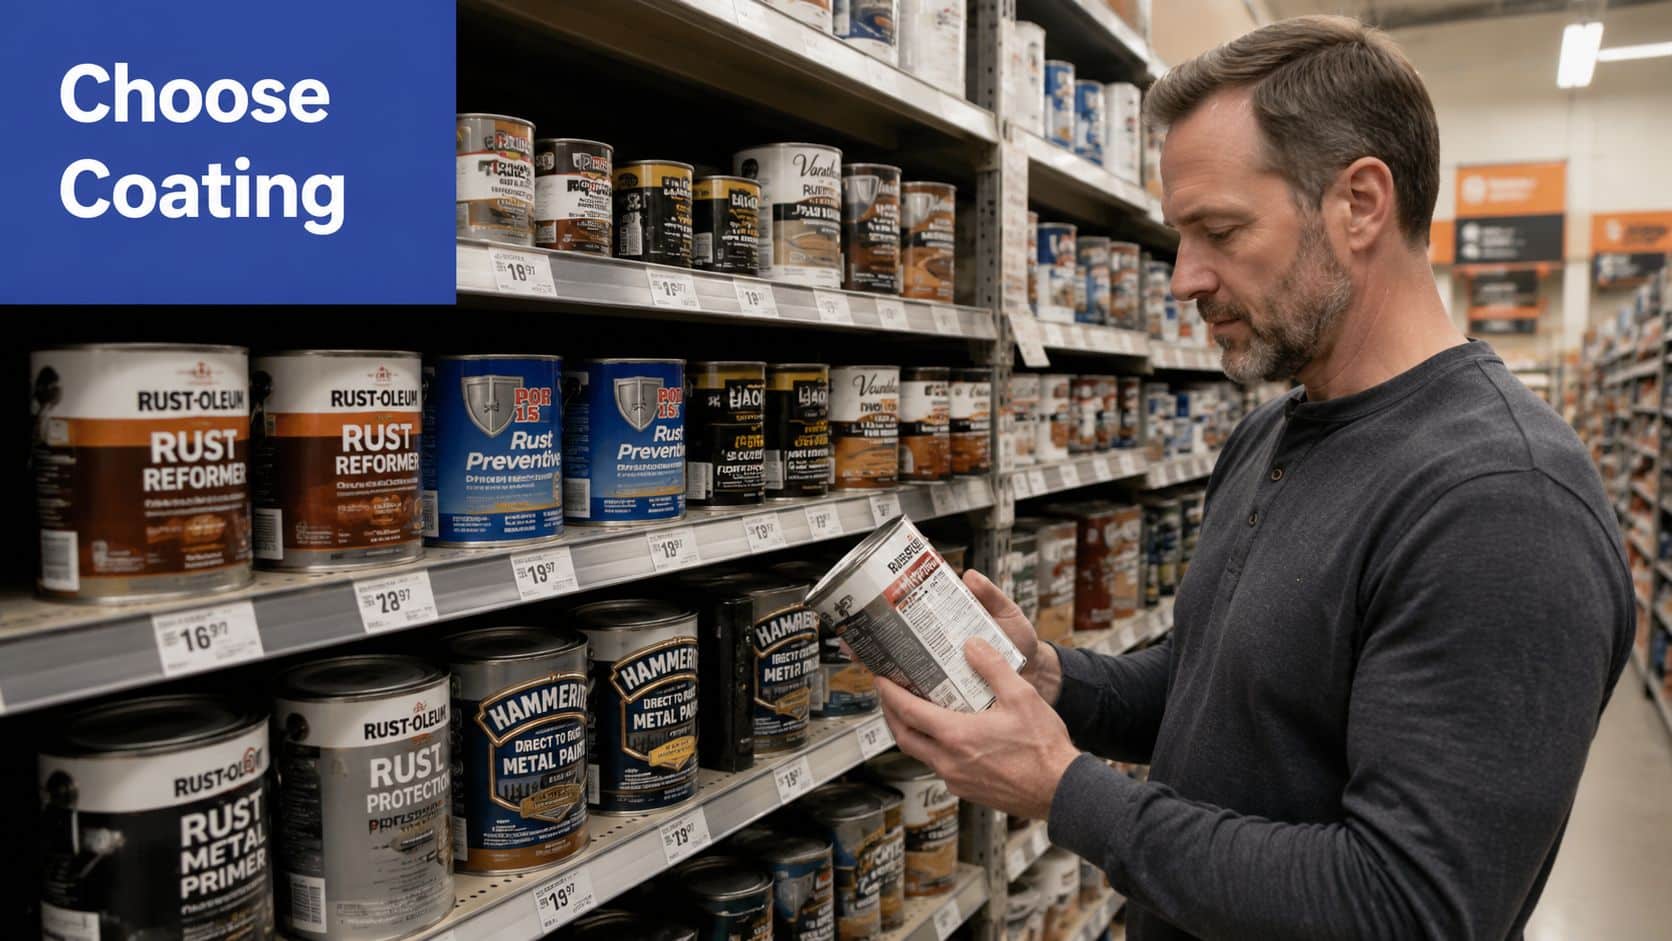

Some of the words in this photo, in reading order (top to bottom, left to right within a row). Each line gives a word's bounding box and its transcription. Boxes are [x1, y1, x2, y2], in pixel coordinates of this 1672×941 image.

[137, 389, 245, 412] RUST-OLEUM
[331, 388, 418, 408] RUST-OLEUM
[513, 386, 552, 407] POR
[514, 405, 540, 424] 15
[150, 428, 238, 464] RUST
[342, 422, 414, 453] RUST
[510, 430, 554, 450] Rust
[335, 451, 420, 475] REFORMER
[465, 450, 561, 471] Preventive
[142, 461, 247, 492] REFORMER
[633, 708, 677, 730] METAL
[555, 732, 566, 746] TO
[370, 742, 445, 789] RUST
[503, 751, 557, 775] METAL
[181, 787, 264, 849] RUST
[181, 822, 267, 876] METAL
[181, 847, 267, 900] PRIMER
